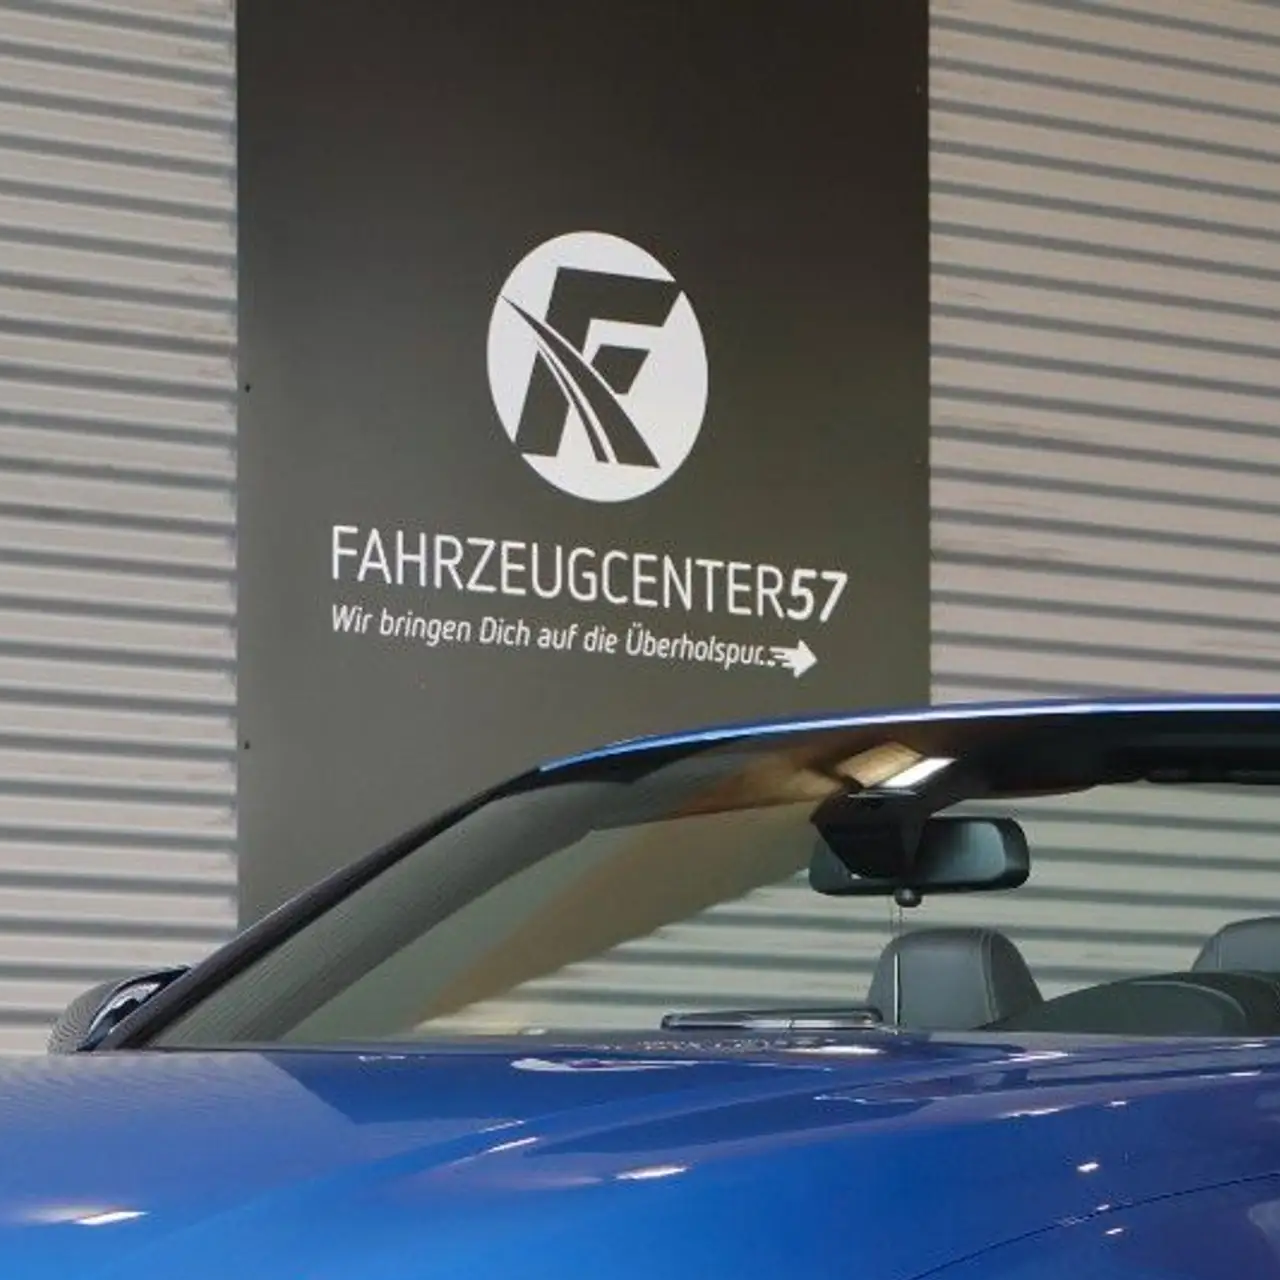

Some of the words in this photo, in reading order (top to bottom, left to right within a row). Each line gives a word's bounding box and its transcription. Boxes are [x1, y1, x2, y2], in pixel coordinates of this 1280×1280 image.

[331, 524, 849, 623] FAHRZEUGCENTER57
[332, 603, 374, 634] Wir
[379, 607, 472, 647] bringen
[479, 615, 531, 648] Dich
[537, 622, 580, 651] auf
[583, 623, 620, 655] die
